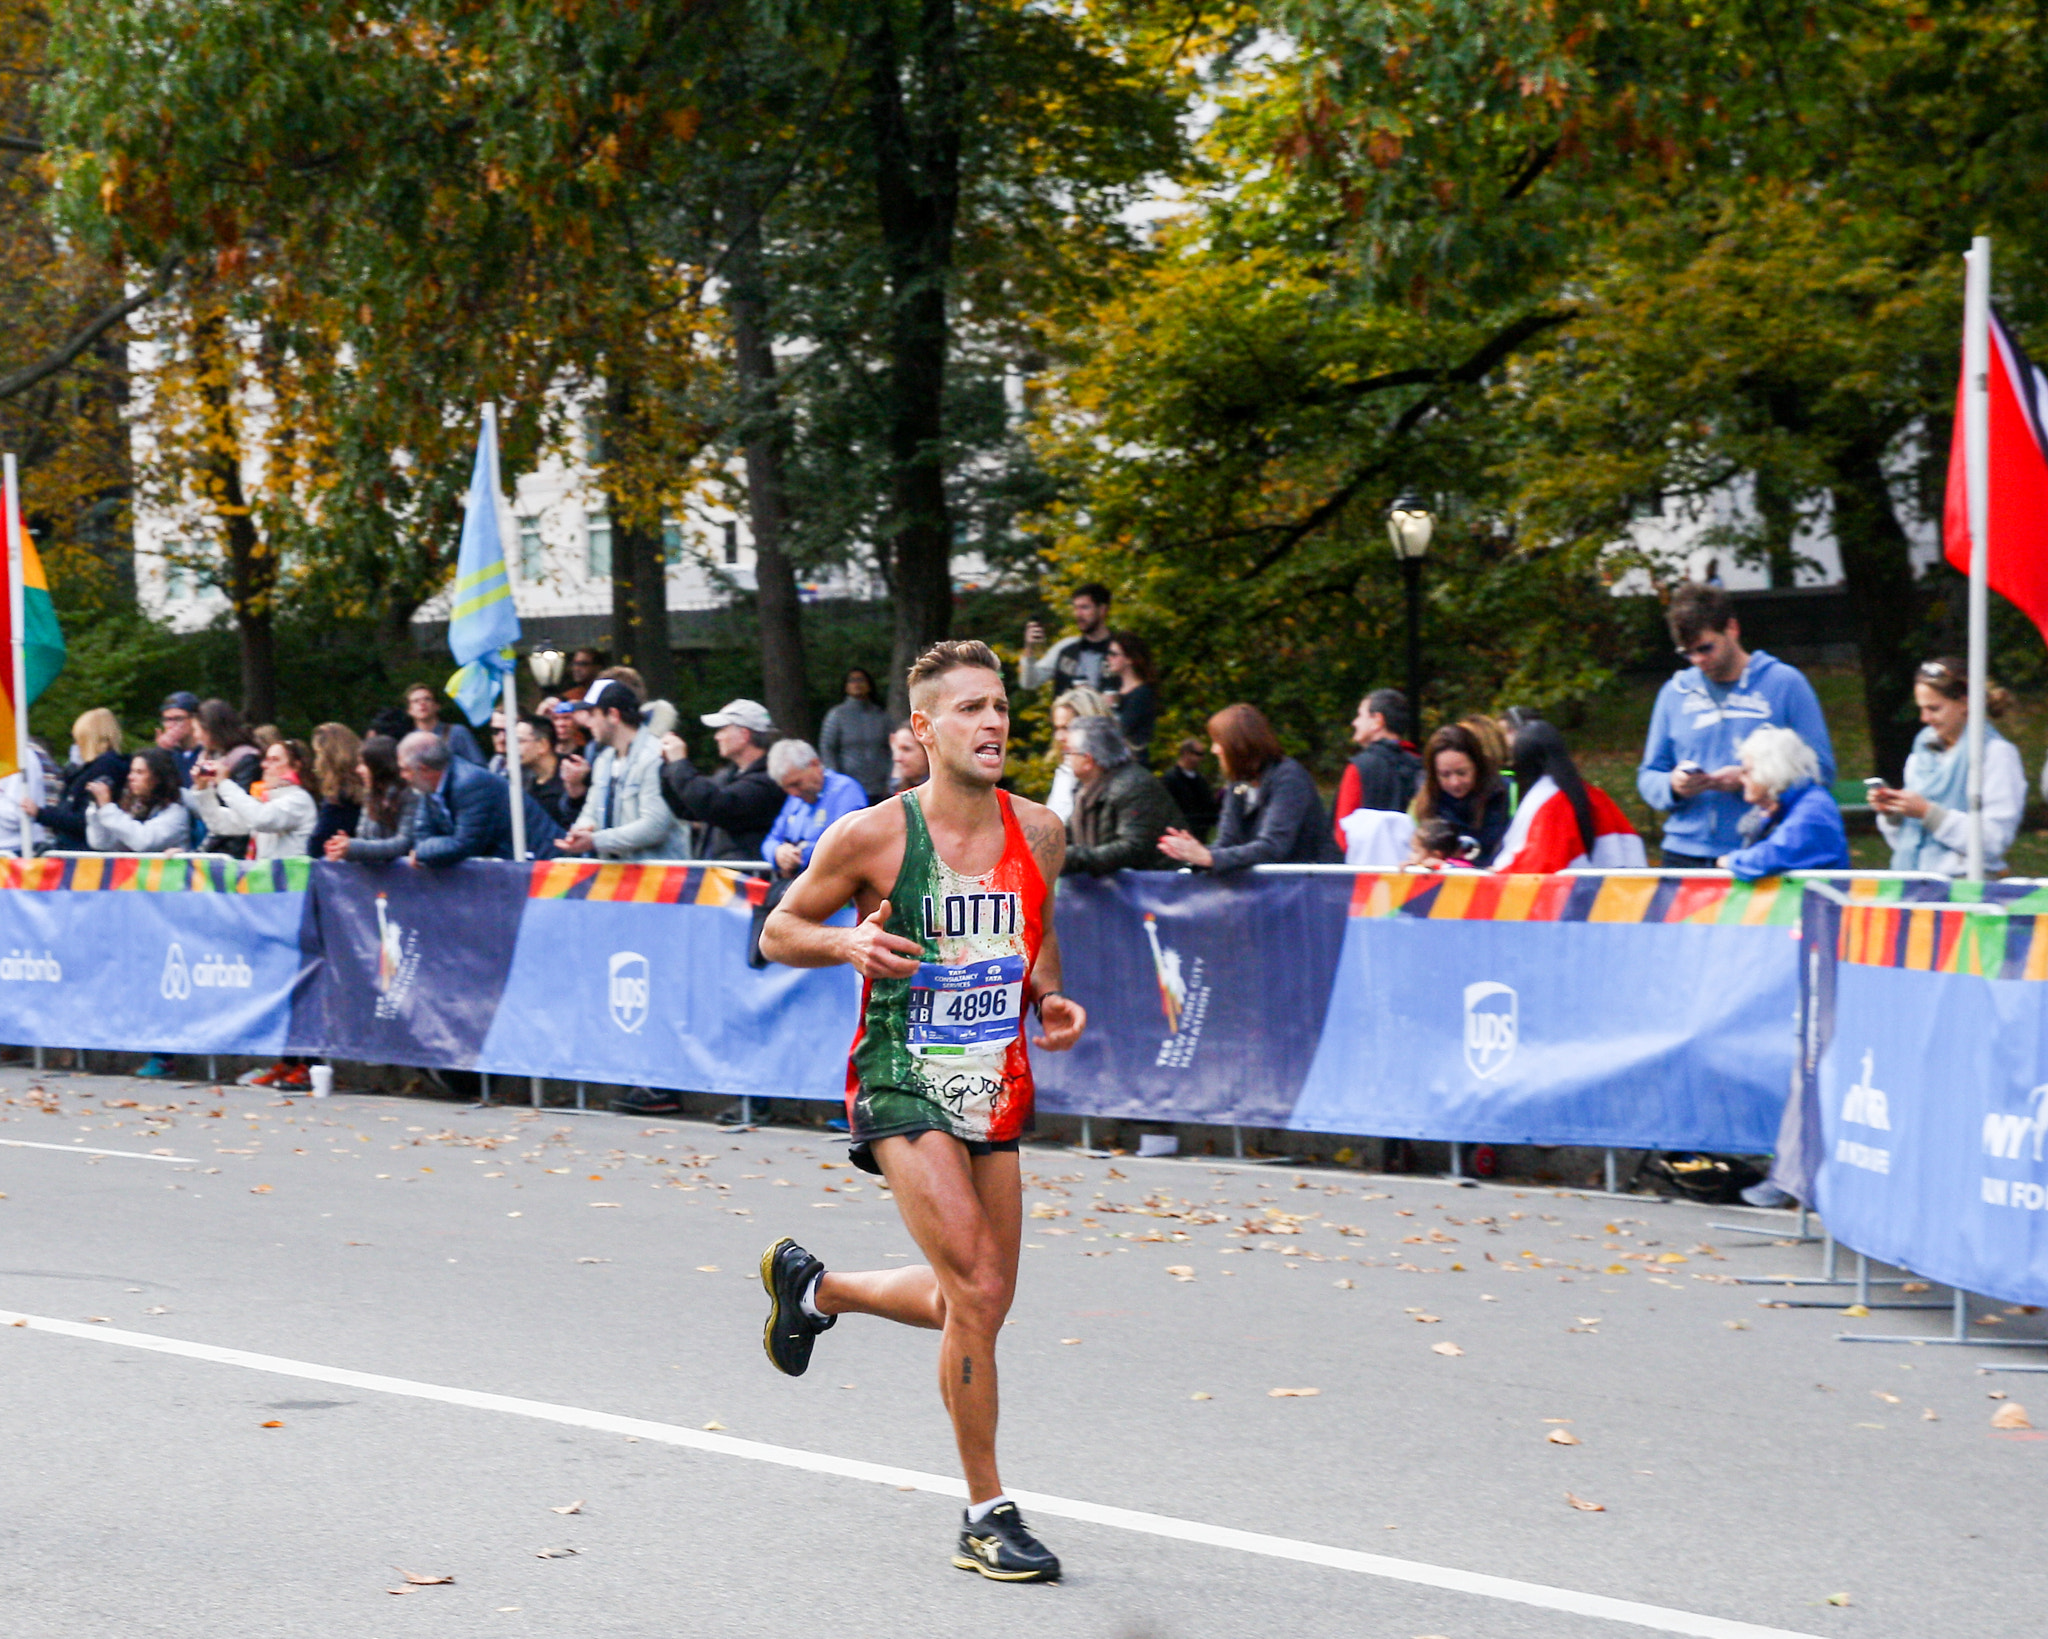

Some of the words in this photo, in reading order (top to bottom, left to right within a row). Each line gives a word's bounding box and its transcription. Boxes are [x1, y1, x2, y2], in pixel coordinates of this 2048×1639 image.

[922, 892, 1017, 939] LOTTI
[0, 950, 62, 982] airbnb
[192, 953, 254, 988] airbnb
[934, 972, 979, 983] CONSULTANCY
[948, 968, 967, 977] TATA
[984, 974, 1003, 983] TATA
[613, 976, 648, 1020] ups
[942, 980, 971, 989] SERVICES
[919, 1007, 930, 1023] B
[946, 988, 1007, 1021] 4896
[1469, 1012, 1513, 1064] ups
[2011, 1181, 2048, 1212] FO
